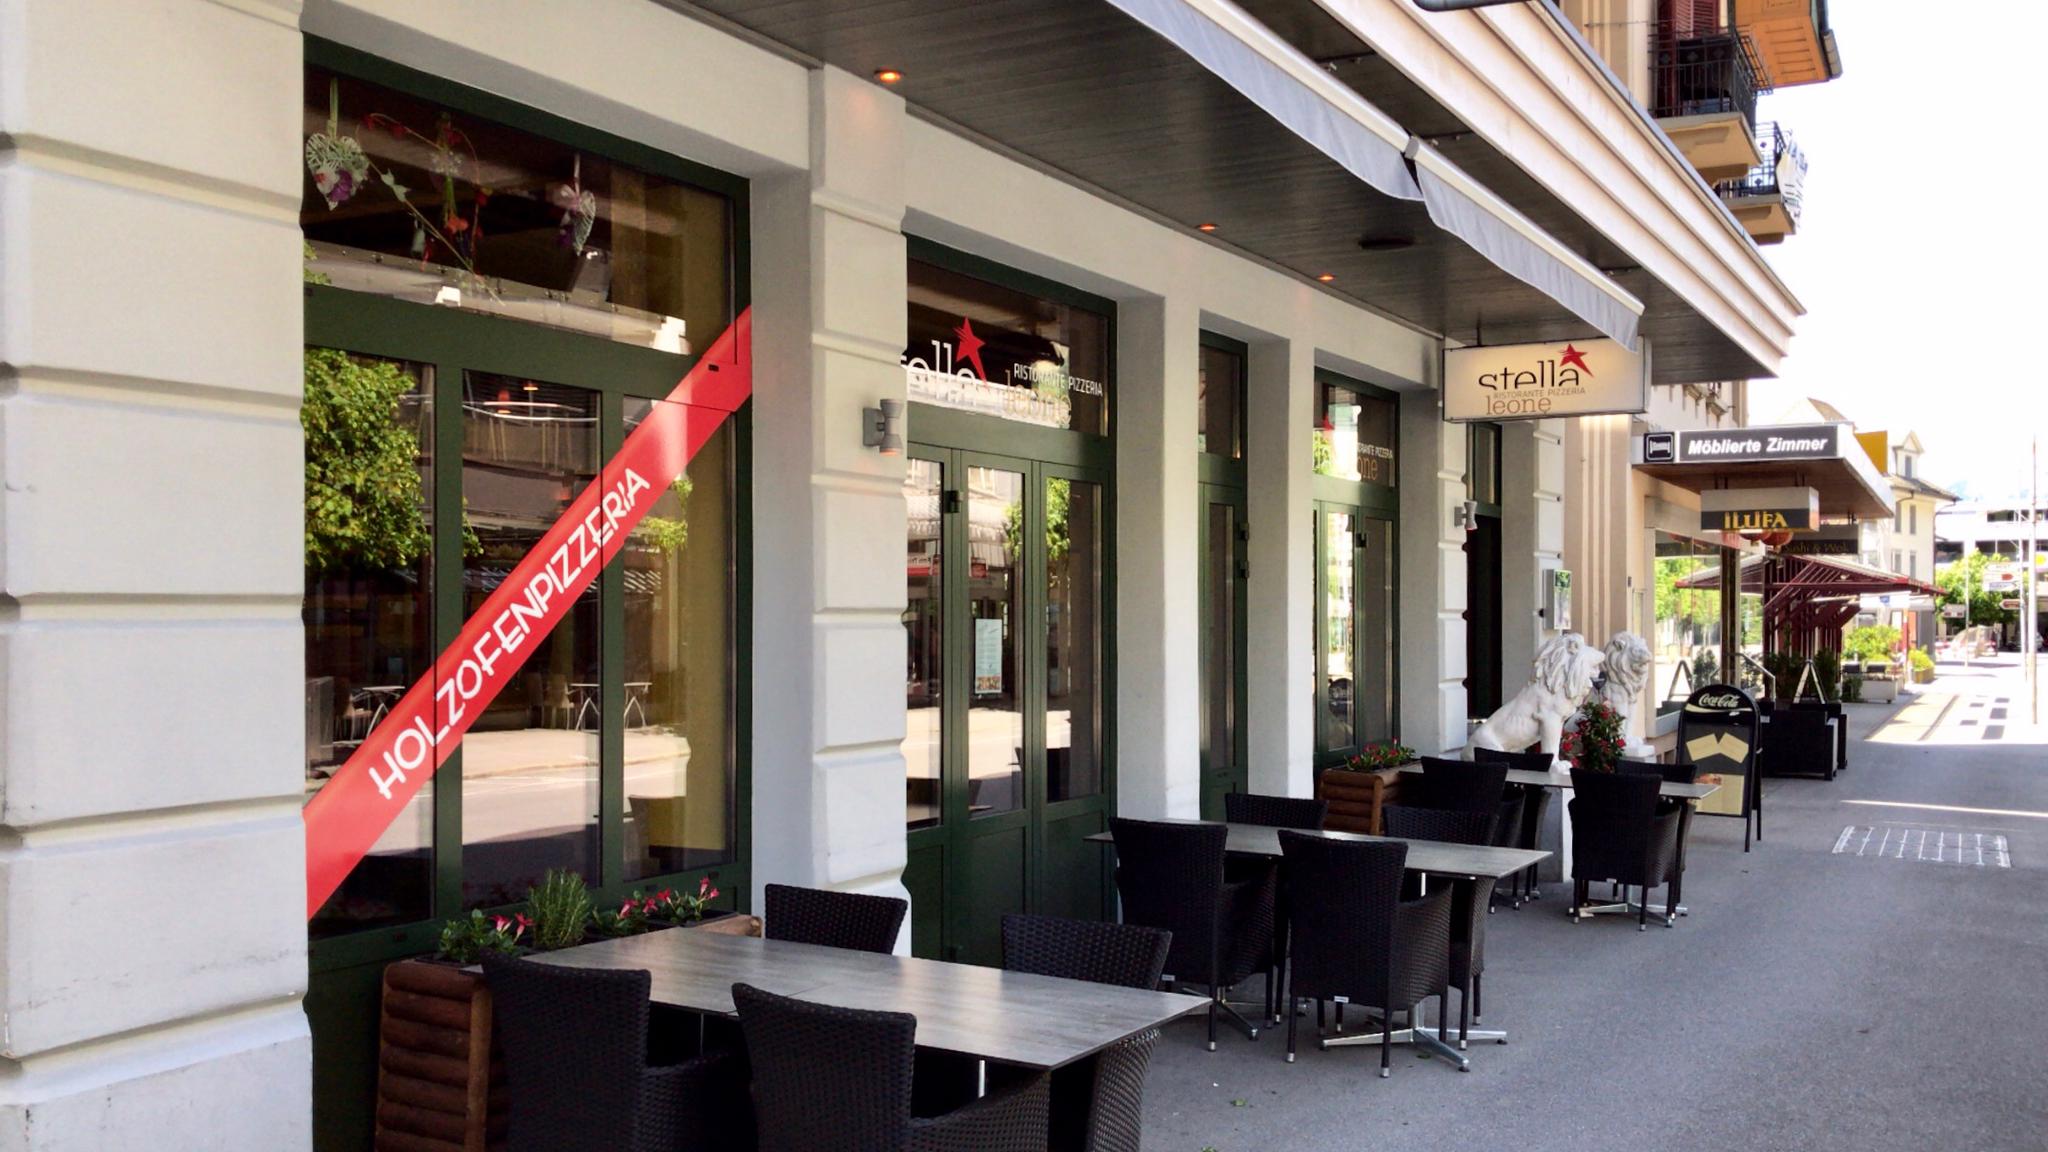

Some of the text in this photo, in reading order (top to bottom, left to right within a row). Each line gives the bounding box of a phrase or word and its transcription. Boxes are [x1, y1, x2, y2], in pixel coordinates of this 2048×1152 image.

[900, 339, 976, 406] ella
[1014, 363, 1103, 397] RISTORANTE PIZZERIA
[1478, 359, 1579, 391] stella
[1486, 395, 1552, 416] leone
[1492, 387, 1587, 400] RISTORANTE PIZZERIA
[1688, 437, 1828, 455] Möblierte Zimmer
[368, 467, 650, 800] HOLZOFENPIZZERIA
